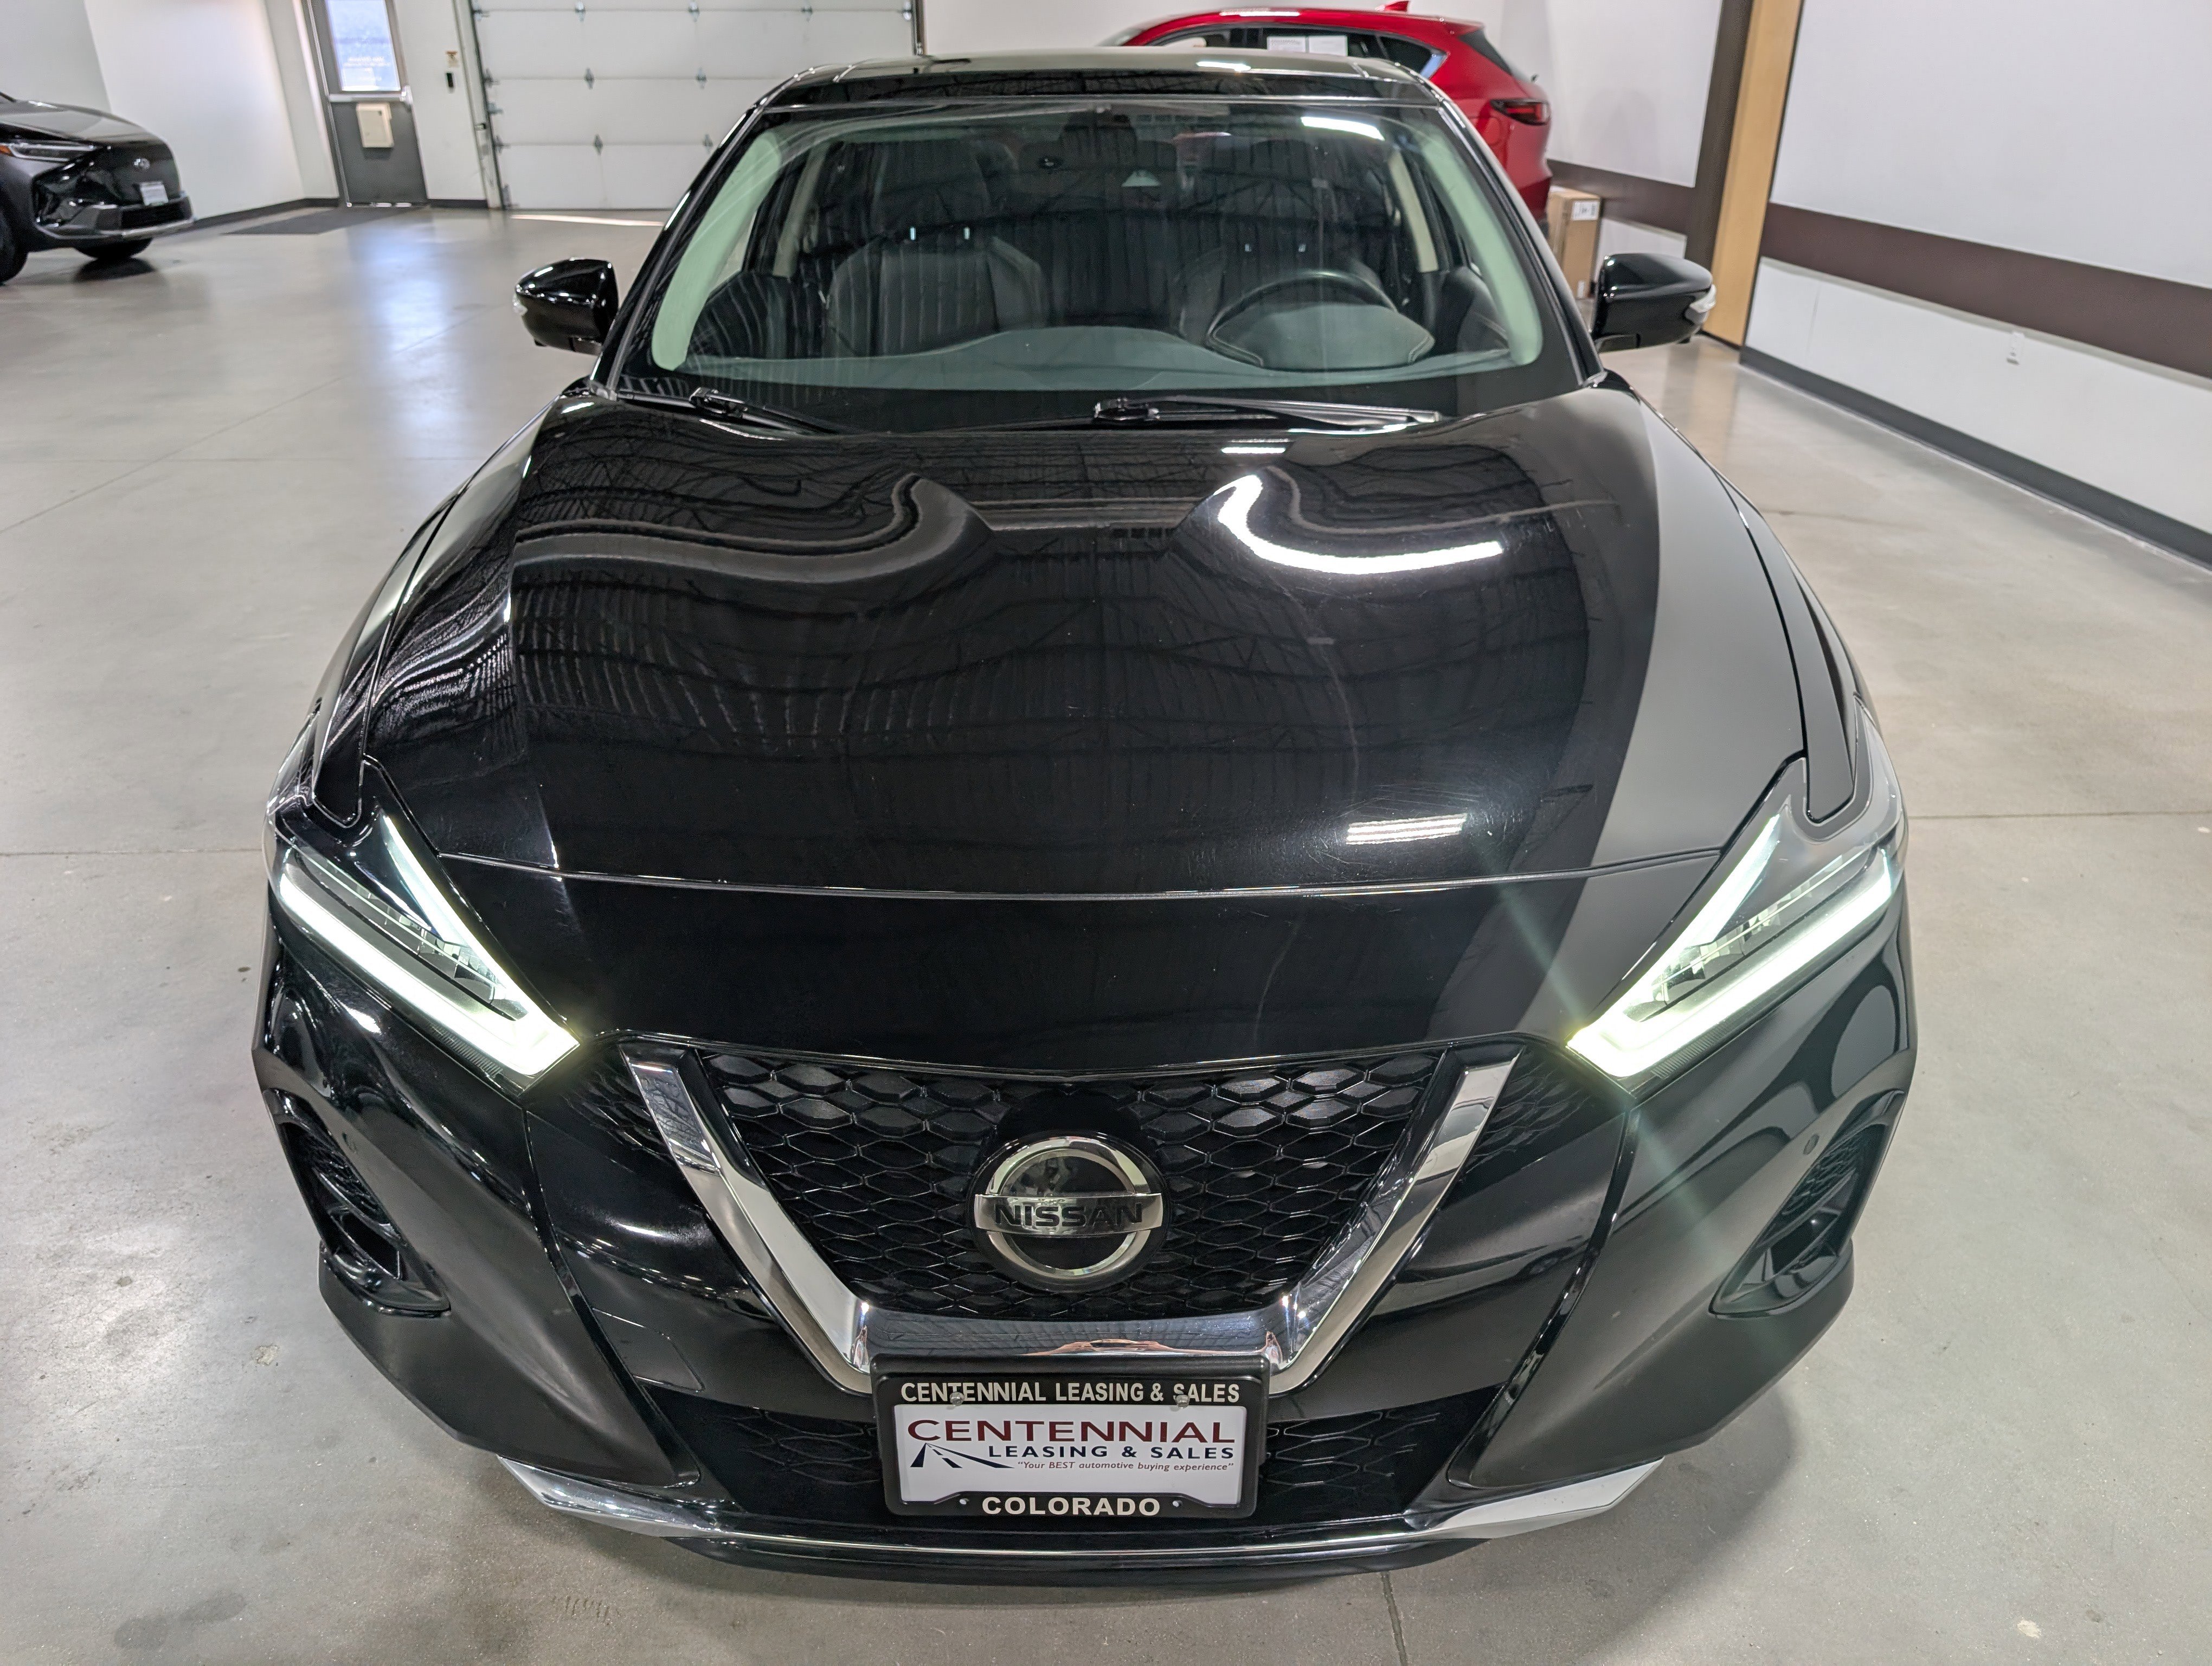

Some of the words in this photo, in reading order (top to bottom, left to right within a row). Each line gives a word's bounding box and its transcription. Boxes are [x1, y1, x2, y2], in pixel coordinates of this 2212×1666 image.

[994, 1202, 1142, 1227] NISSAN
[901, 1382, 1046, 1402] CENTENNIAL
[1056, 1382, 1144, 1402] LEASING
[1150, 1382, 1164, 1402] &
[1173, 1383, 1240, 1403] SALES
[907, 1419, 1236, 1443] CENTENNIAL
[988, 1445, 1108, 1458] LEASING
[1121, 1446, 1137, 1458] &
[1150, 1446, 1233, 1459] SALES
[1049, 1461, 1076, 1469] BEST
[1078, 1462, 1134, 1470] automotive
[1137, 1462, 1170, 1472] buying
[982, 1496, 1160, 1516] COLORADO
